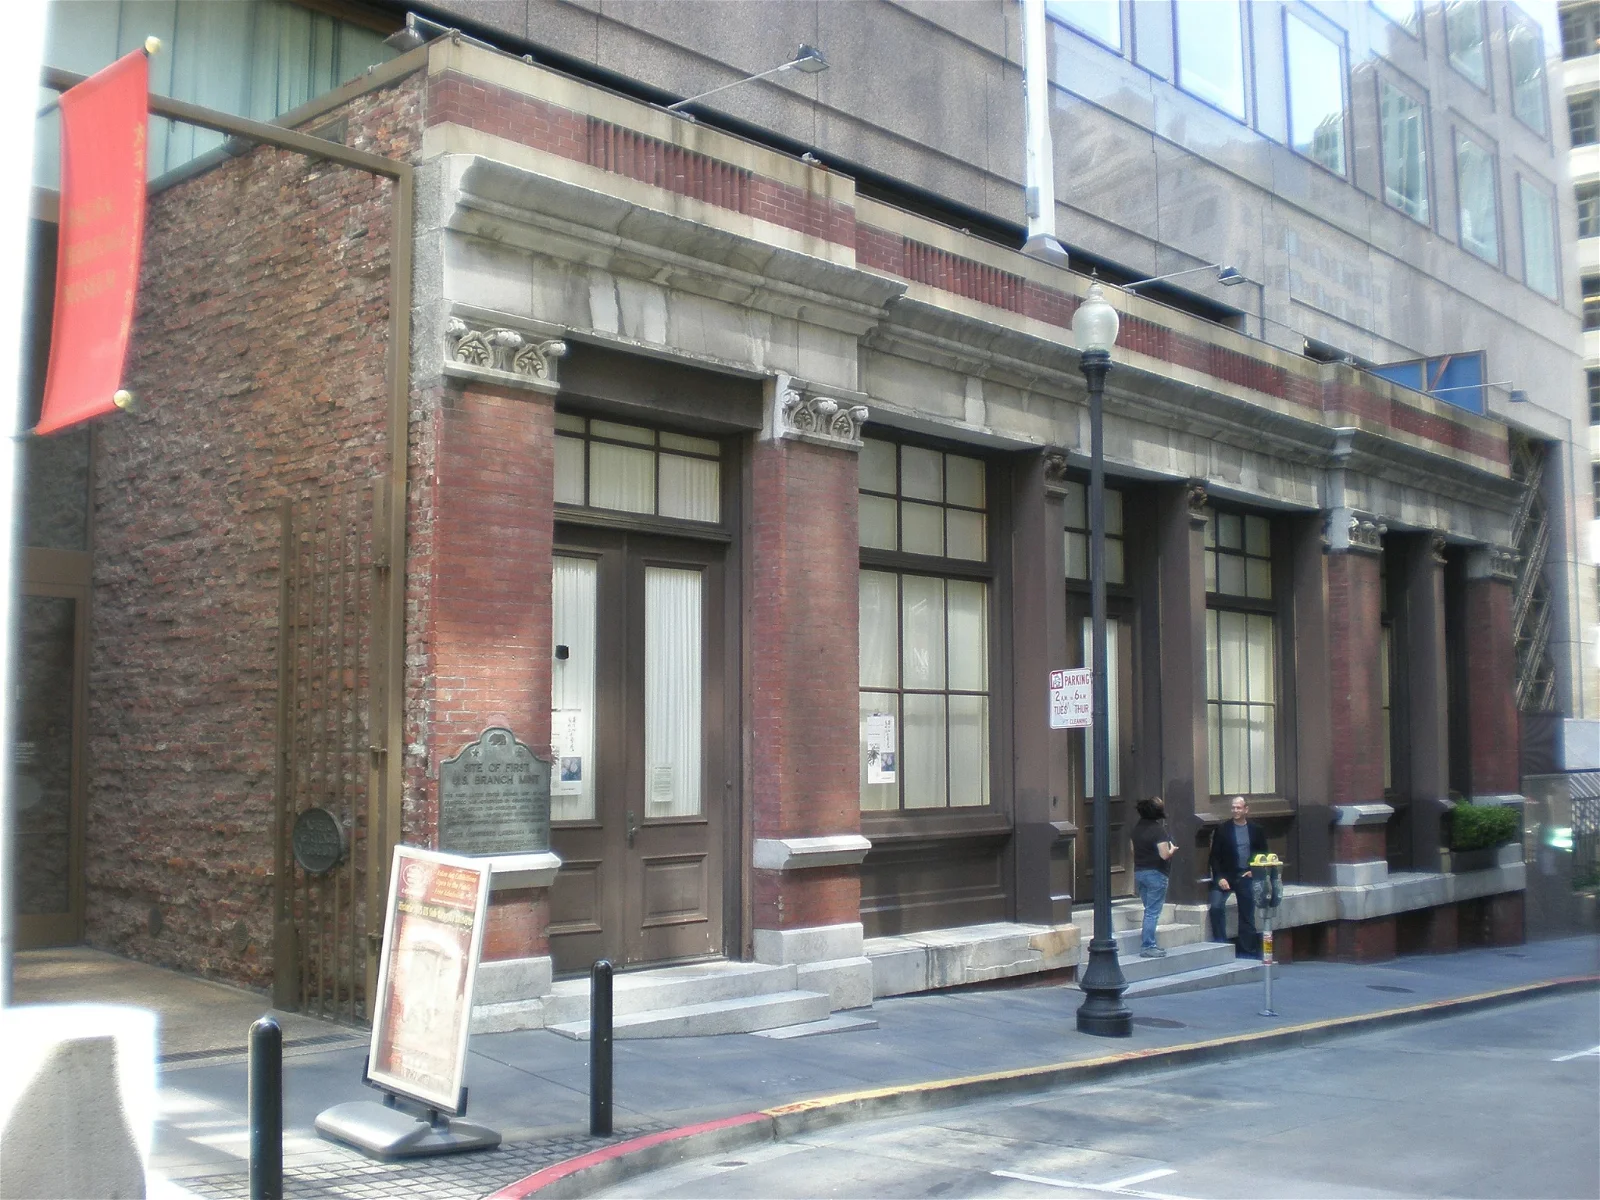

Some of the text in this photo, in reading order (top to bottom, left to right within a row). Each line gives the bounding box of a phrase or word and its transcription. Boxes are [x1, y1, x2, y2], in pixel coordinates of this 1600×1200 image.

[1065, 674, 1089, 686] PARKING
[1055, 690, 1060, 702] 2
[1074, 690, 1080, 700] 6
[1054, 706, 1068, 714] TUES
[464, 763, 530, 773] SITE OF FIRST
[474, 775, 514, 785] BRANCH
[519, 775, 540, 784] MINT
